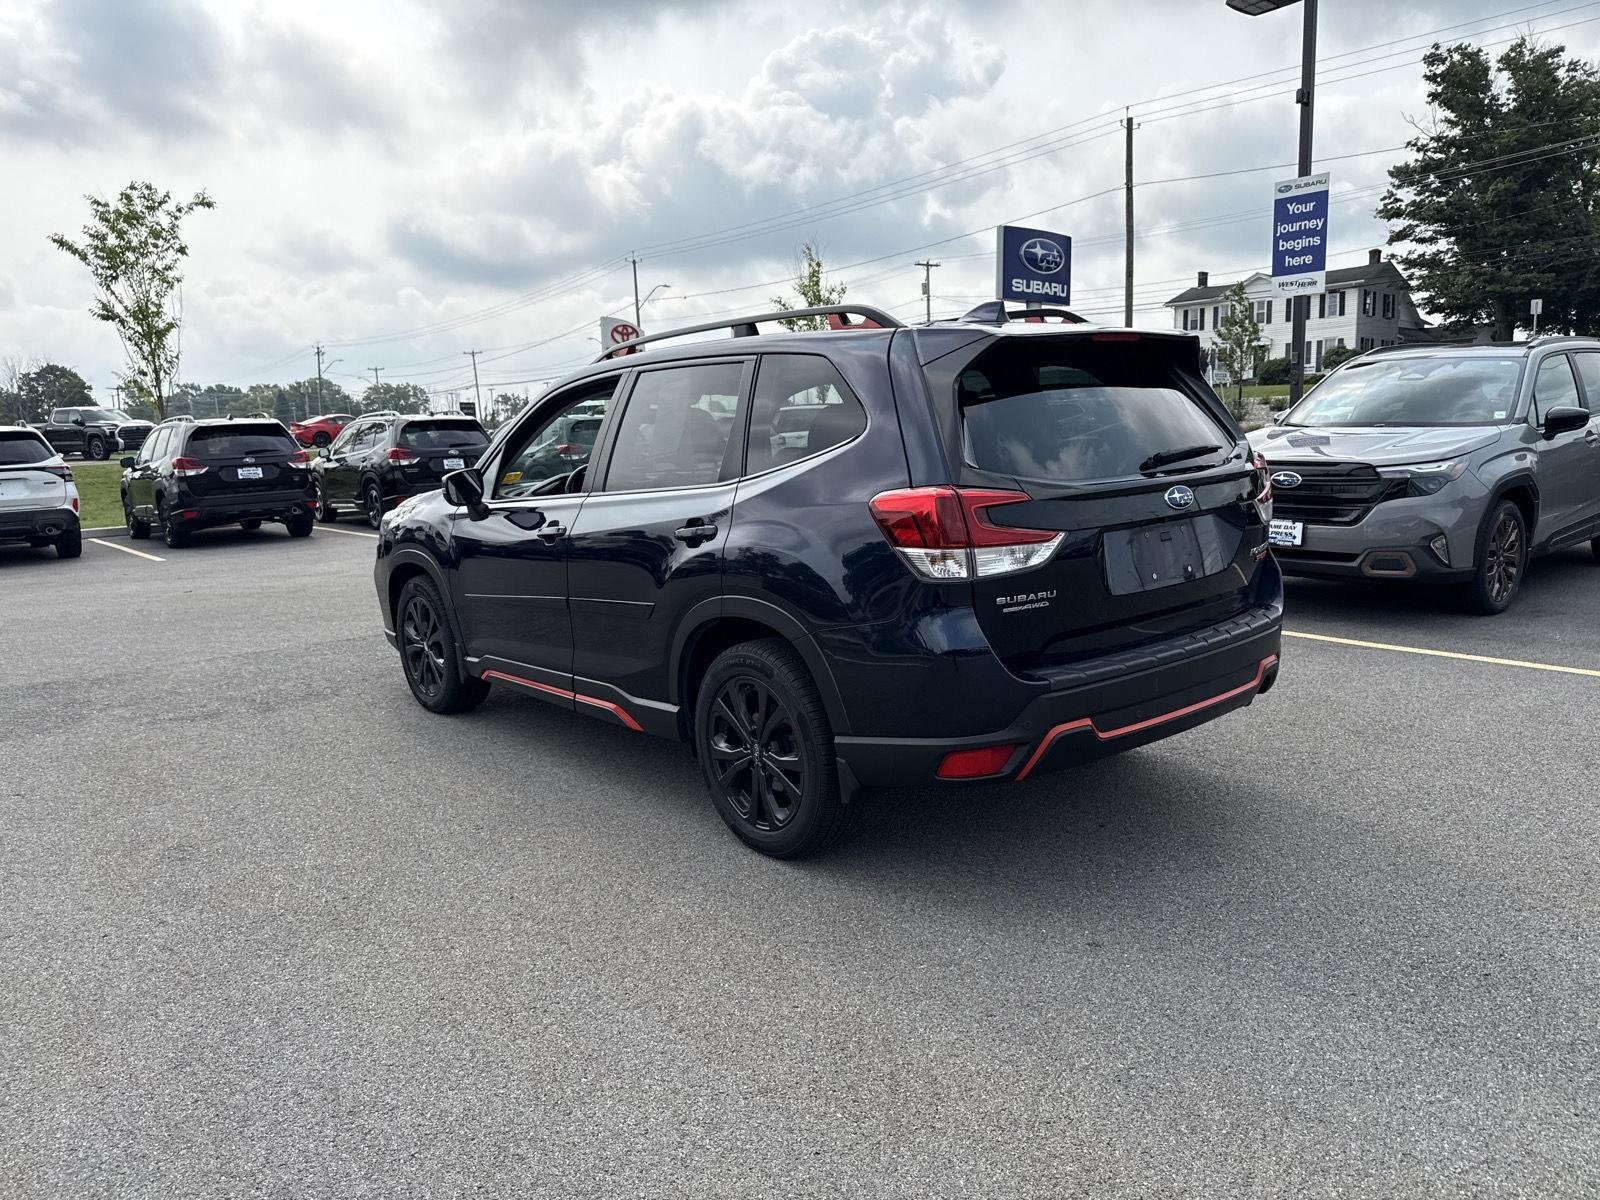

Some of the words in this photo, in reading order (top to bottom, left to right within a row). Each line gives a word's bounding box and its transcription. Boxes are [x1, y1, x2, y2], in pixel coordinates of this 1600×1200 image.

[1294, 179, 1327, 190] SUBARU
[1286, 202, 1315, 215] Your
[1276, 218, 1325, 236] journey
[1278, 236, 1321, 251] begins
[1285, 254, 1313, 267] here
[1011, 278, 1067, 297] SUBARU
[996, 590, 1056, 605] SUBARU
